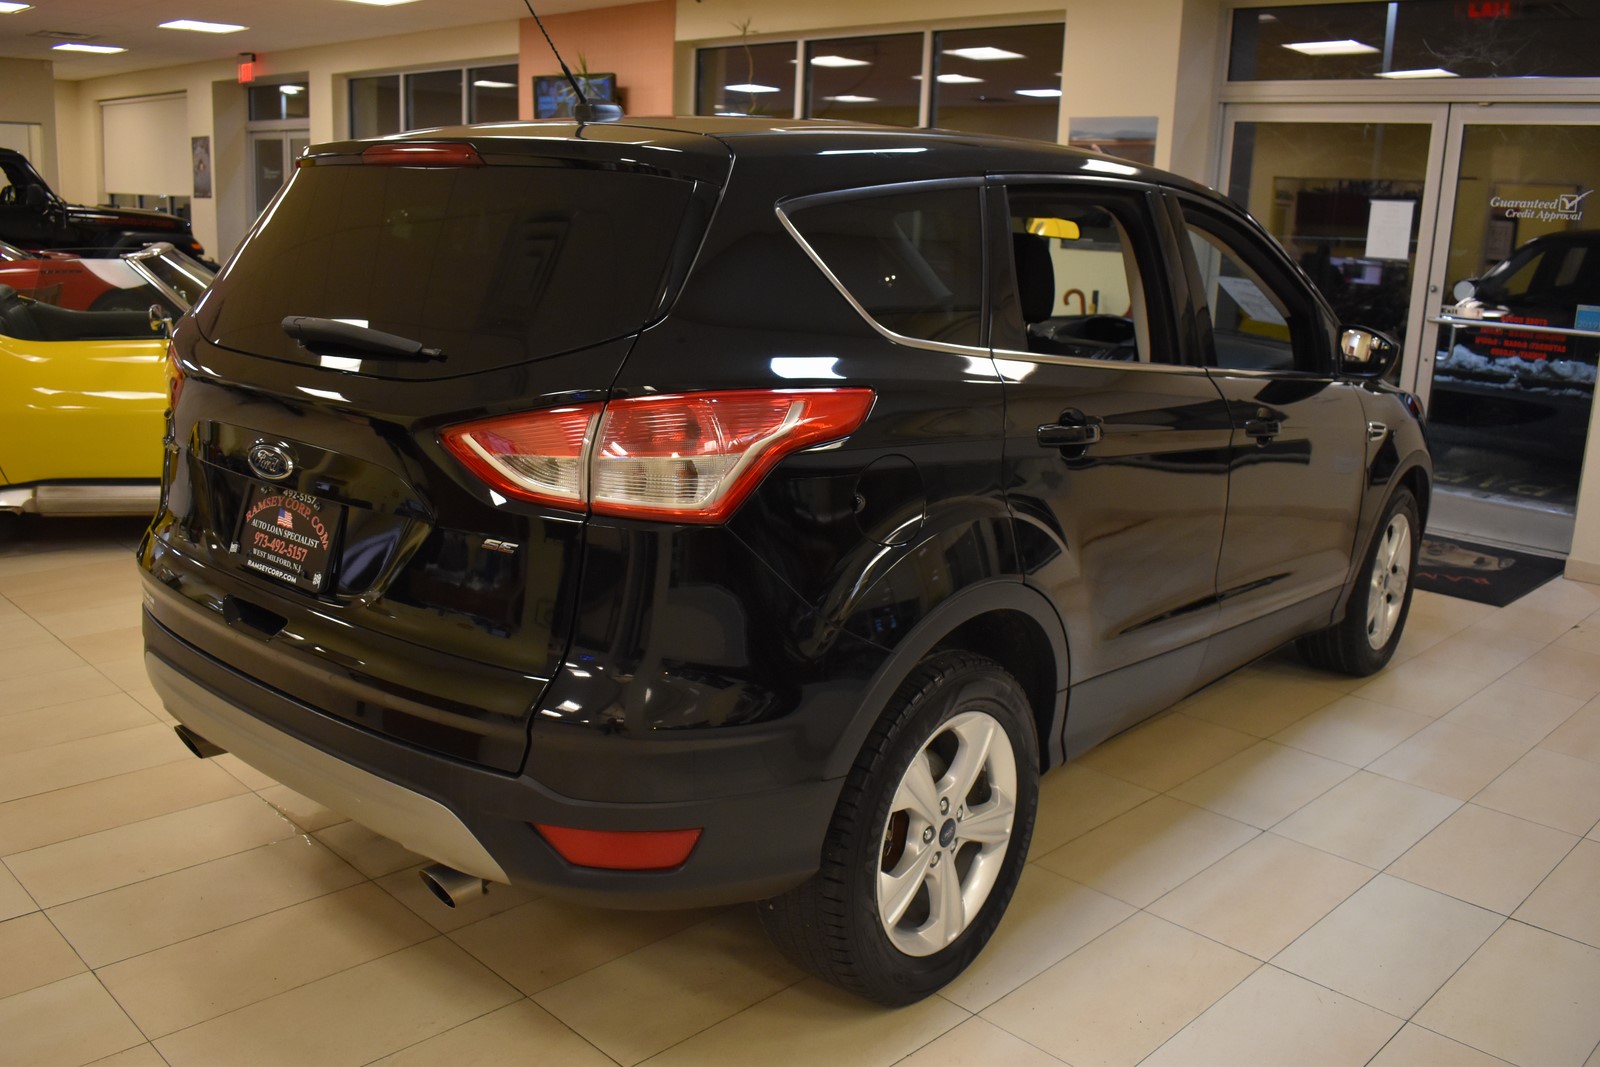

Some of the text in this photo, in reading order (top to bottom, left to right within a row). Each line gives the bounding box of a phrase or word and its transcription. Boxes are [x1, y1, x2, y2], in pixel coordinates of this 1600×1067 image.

[1490, 196, 1559, 209] Guaranteed
[1505, 208, 1582, 222] Credit Approval
[245, 495, 285, 523] RAMSEY
[311, 516, 329, 551] COM
[251, 518, 319, 549] AUTO LOAN SPECIALIST
[253, 531, 308, 562] 973-492-5157
[481, 538, 519, 555] SE
[252, 548, 267, 559] WEST
[266, 552, 292, 570] MILFORD,
[247, 559, 297, 584] RAMSEYCORP.COM
